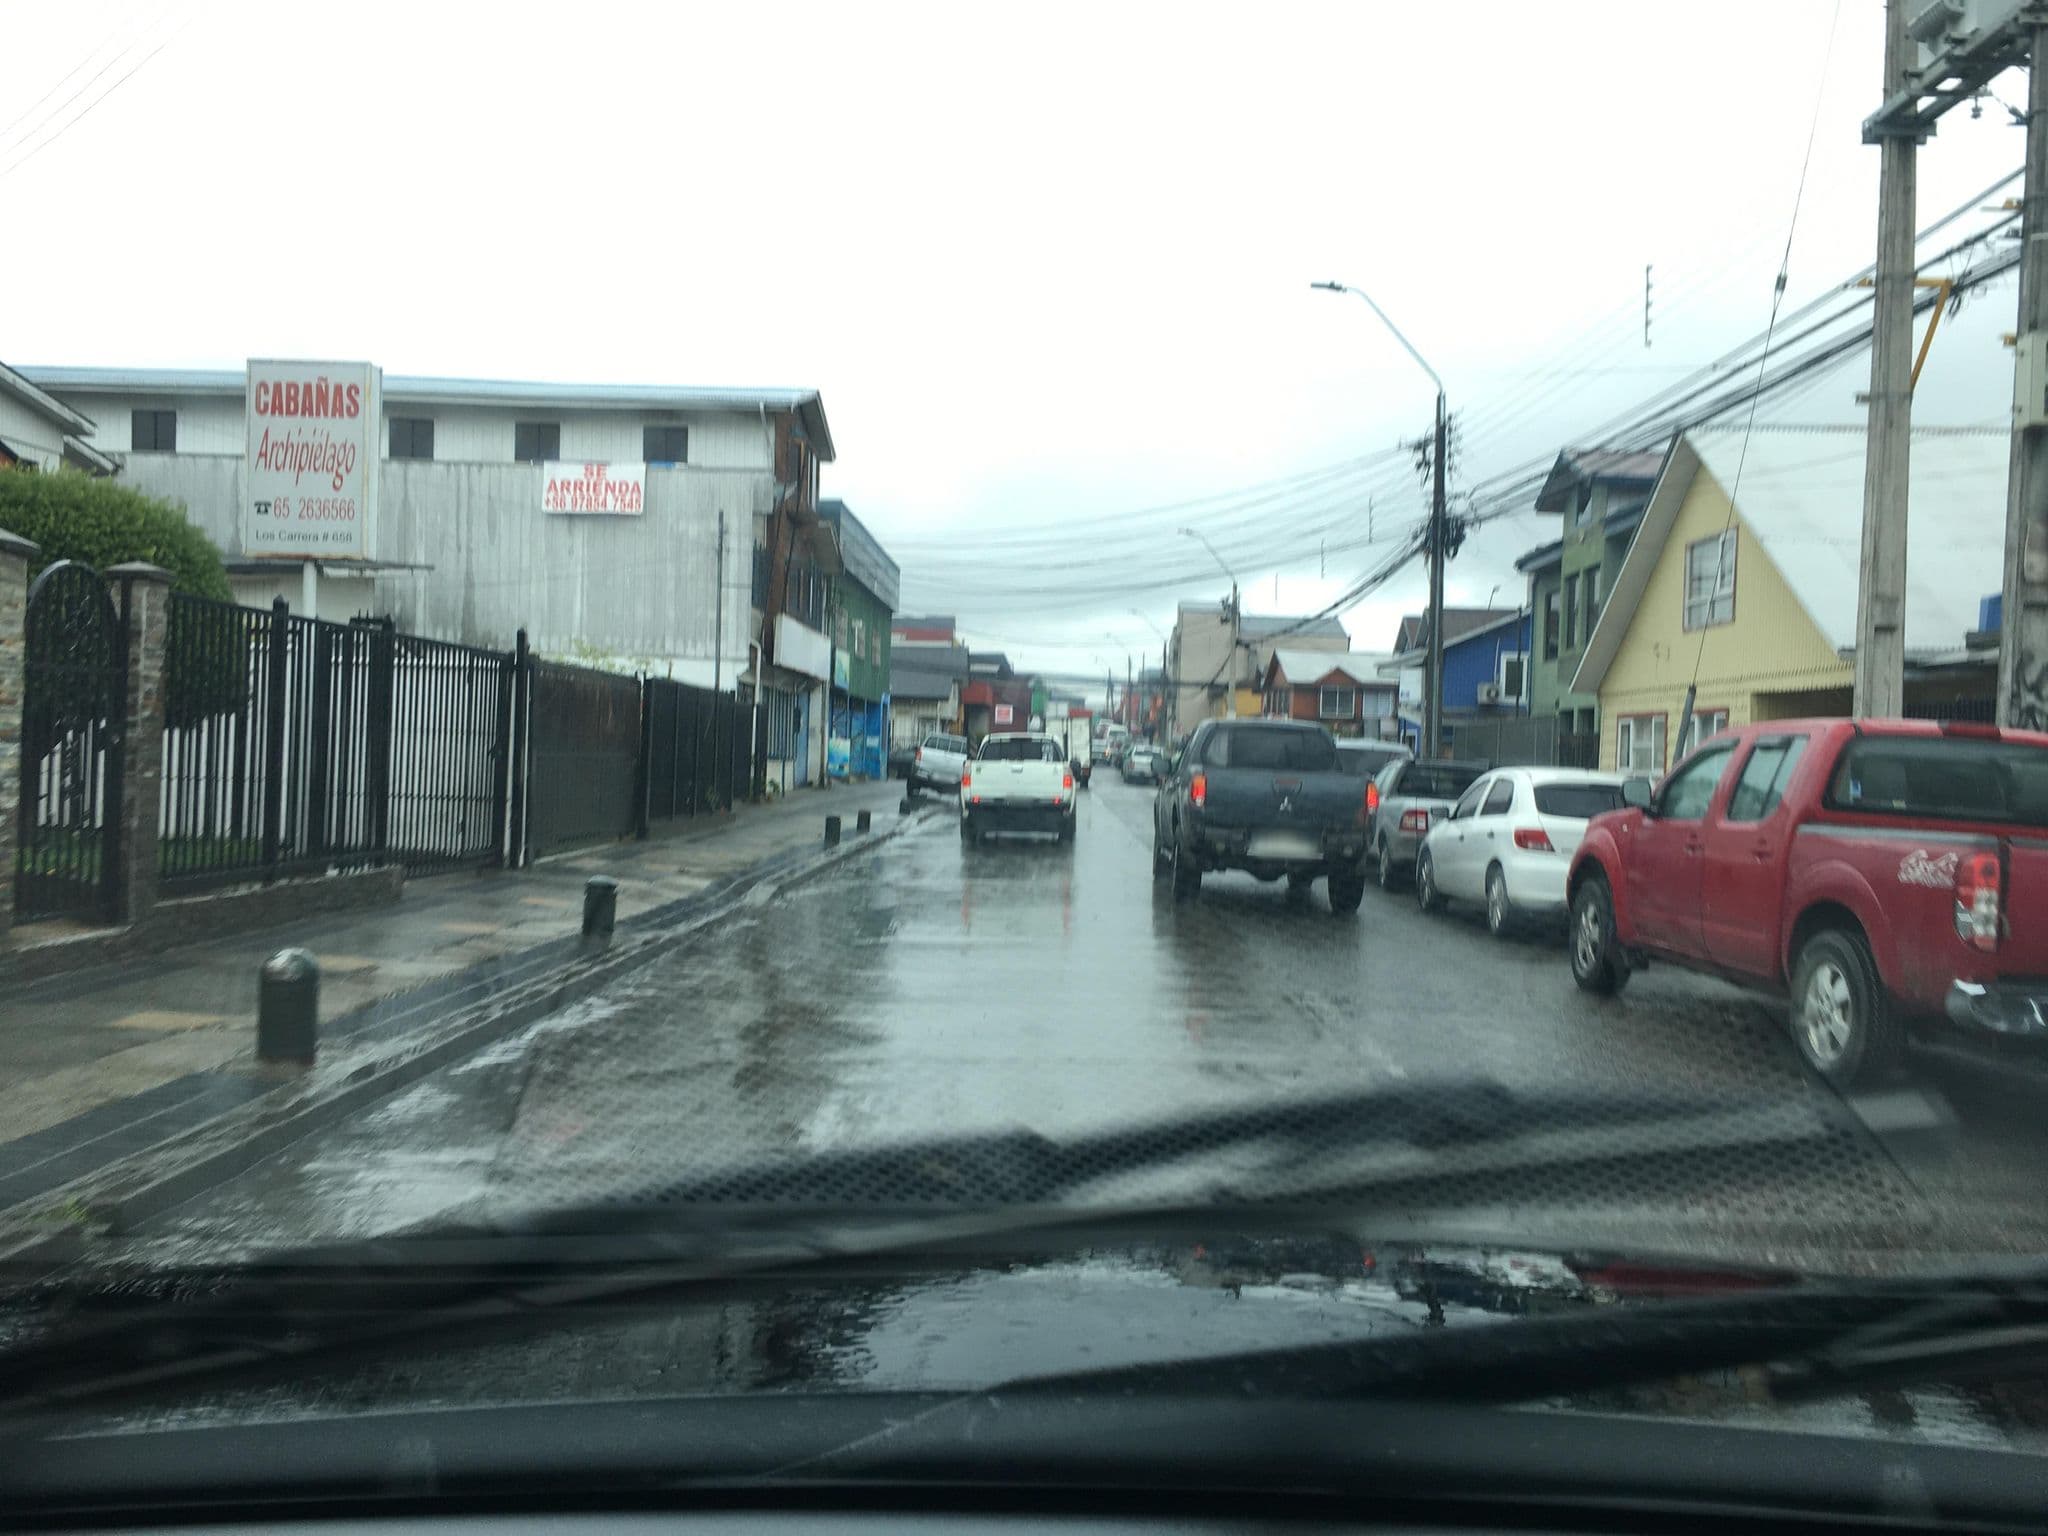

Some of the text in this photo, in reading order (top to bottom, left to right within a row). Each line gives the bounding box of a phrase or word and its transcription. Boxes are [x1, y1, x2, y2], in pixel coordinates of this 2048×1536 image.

[255, 376, 360, 418] CABAÑAS
[255, 426, 356, 491] Archipiélago
[584, 463, 607, 479] SE
[547, 479, 642, 498] ARRIENDA
[273, 496, 355, 520] 65 2636566
[256, 530, 275, 541] Los
